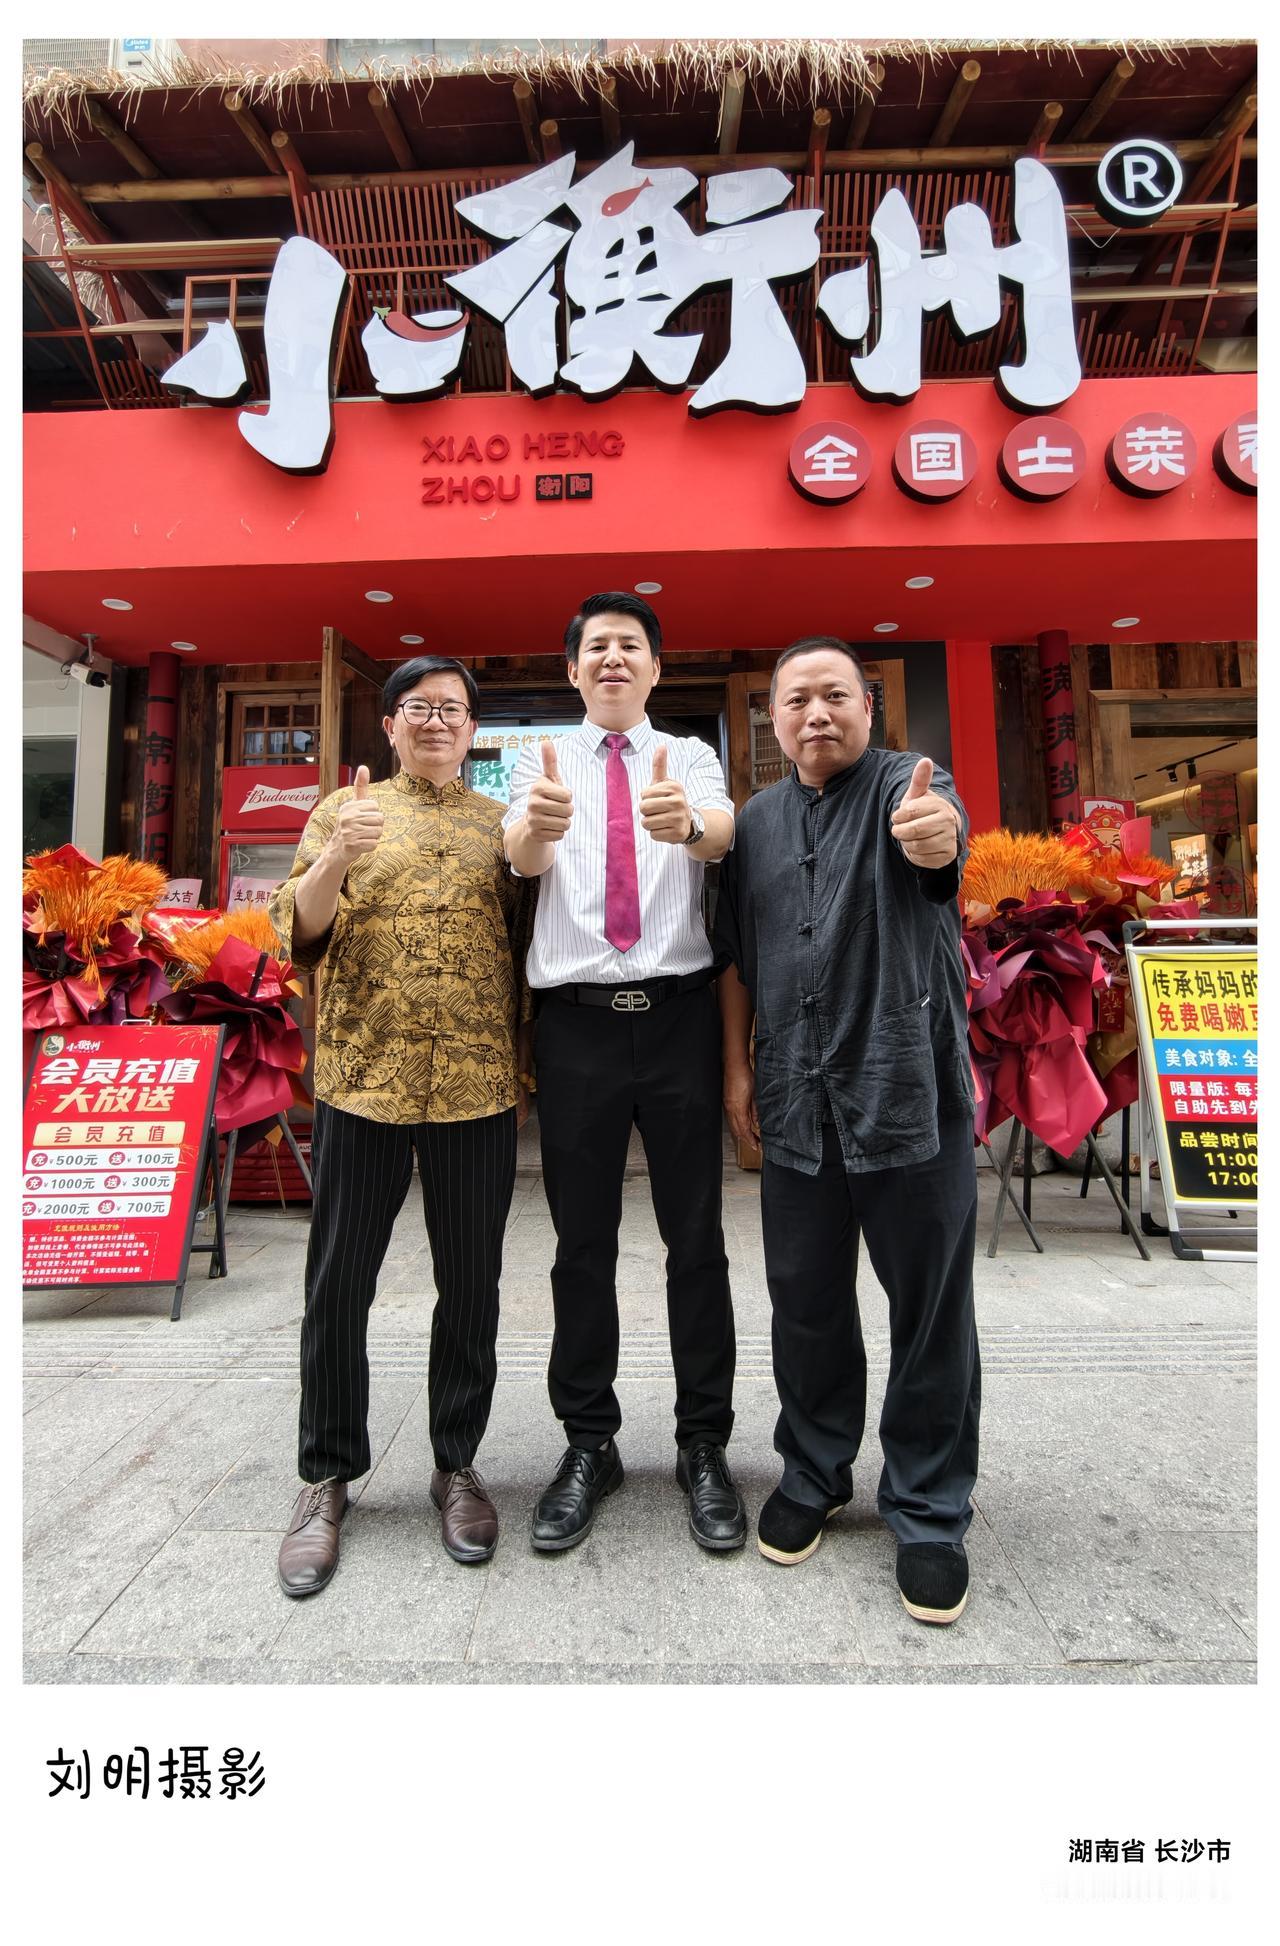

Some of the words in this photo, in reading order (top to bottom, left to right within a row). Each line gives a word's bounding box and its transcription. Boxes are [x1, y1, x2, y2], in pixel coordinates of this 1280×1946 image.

[160, 140, 1082, 472] 小衡州
[422, 435, 510, 463] XIAO
[524, 431, 625, 460] HENG
[421, 474, 521, 504] ZHOU
[246, 789, 319, 804] Budweiser
[1152, 969, 1257, 998] 传承妈妈的
[41, 1058, 200, 1084] 会员充值
[52, 1086, 175, 1113] 大放送
[54, 1126, 165, 1143] 会员充值
[1180, 1131, 1257, 1148] 品尝时间
